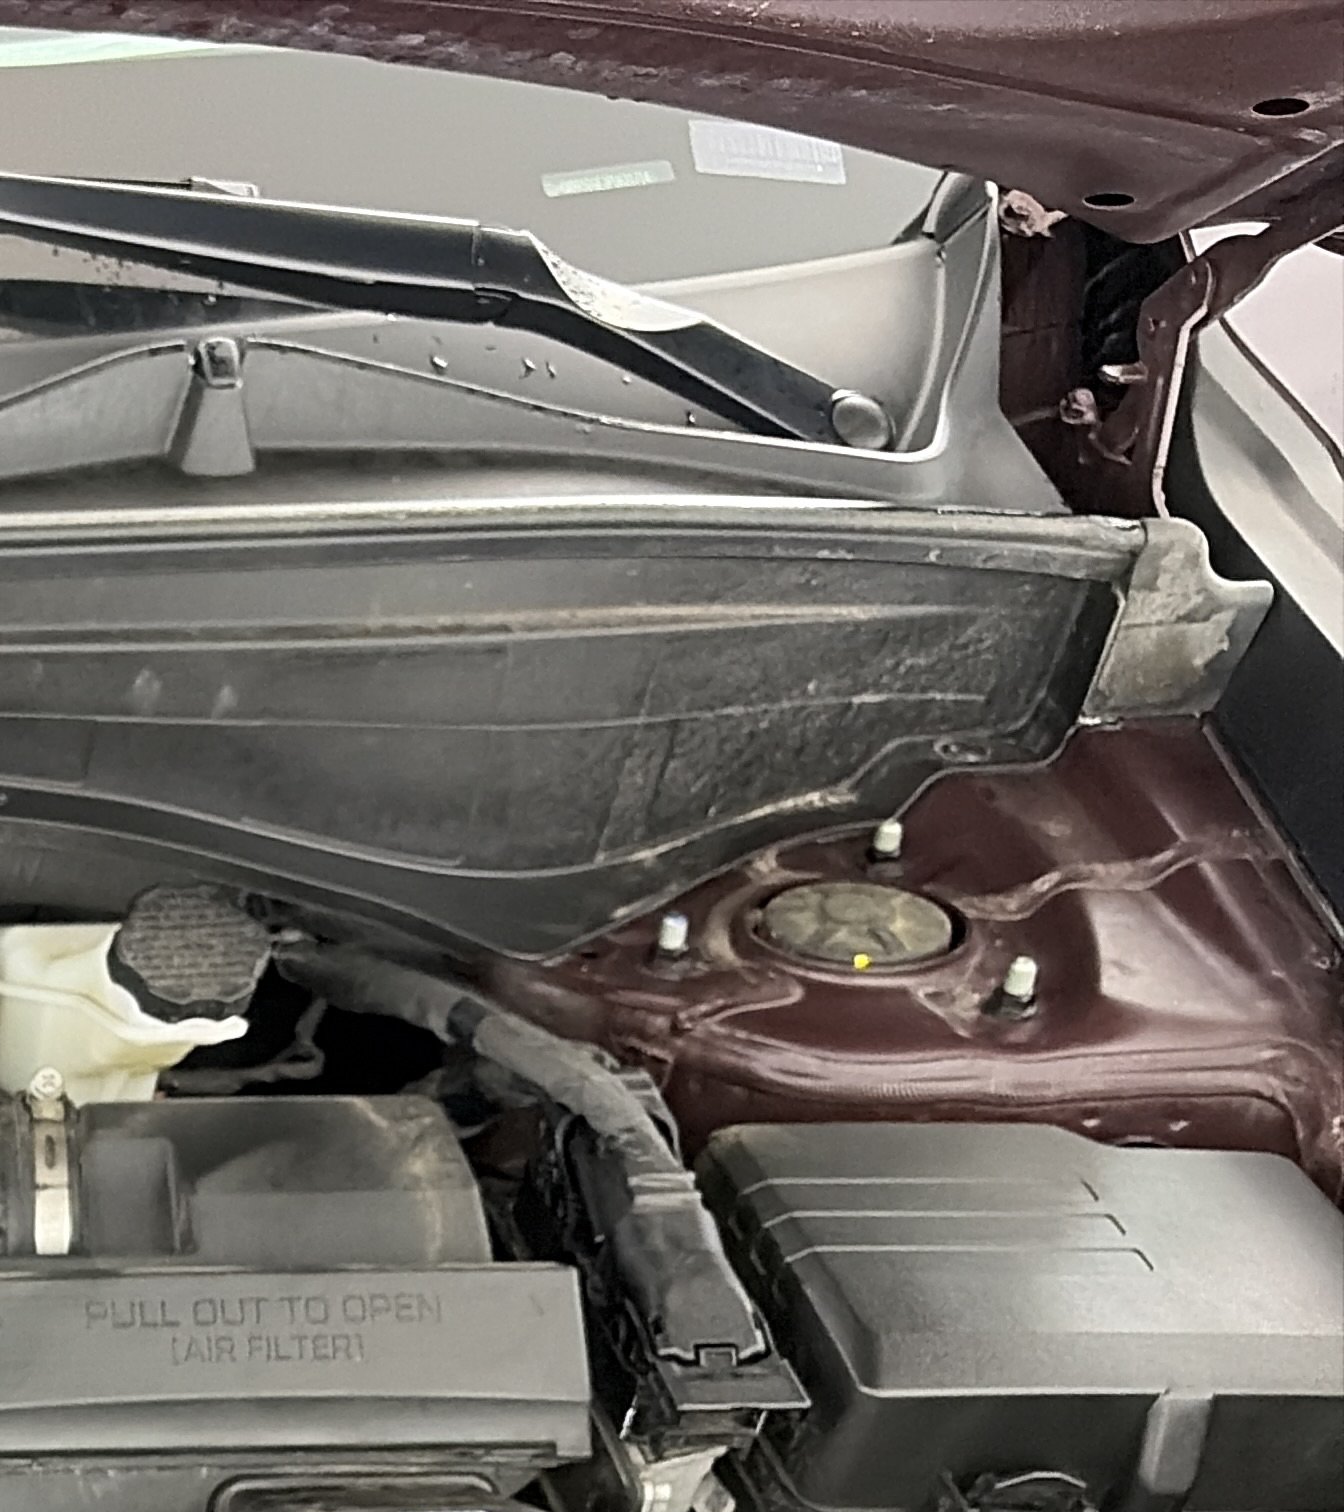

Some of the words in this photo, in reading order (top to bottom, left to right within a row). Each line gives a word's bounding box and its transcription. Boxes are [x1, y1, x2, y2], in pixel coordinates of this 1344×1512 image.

[85, 1299, 181, 1329] PULL
[193, 1296, 268, 1326] OUT
[280, 1296, 329, 1325] TO
[343, 1293, 442, 1324] OPEN
